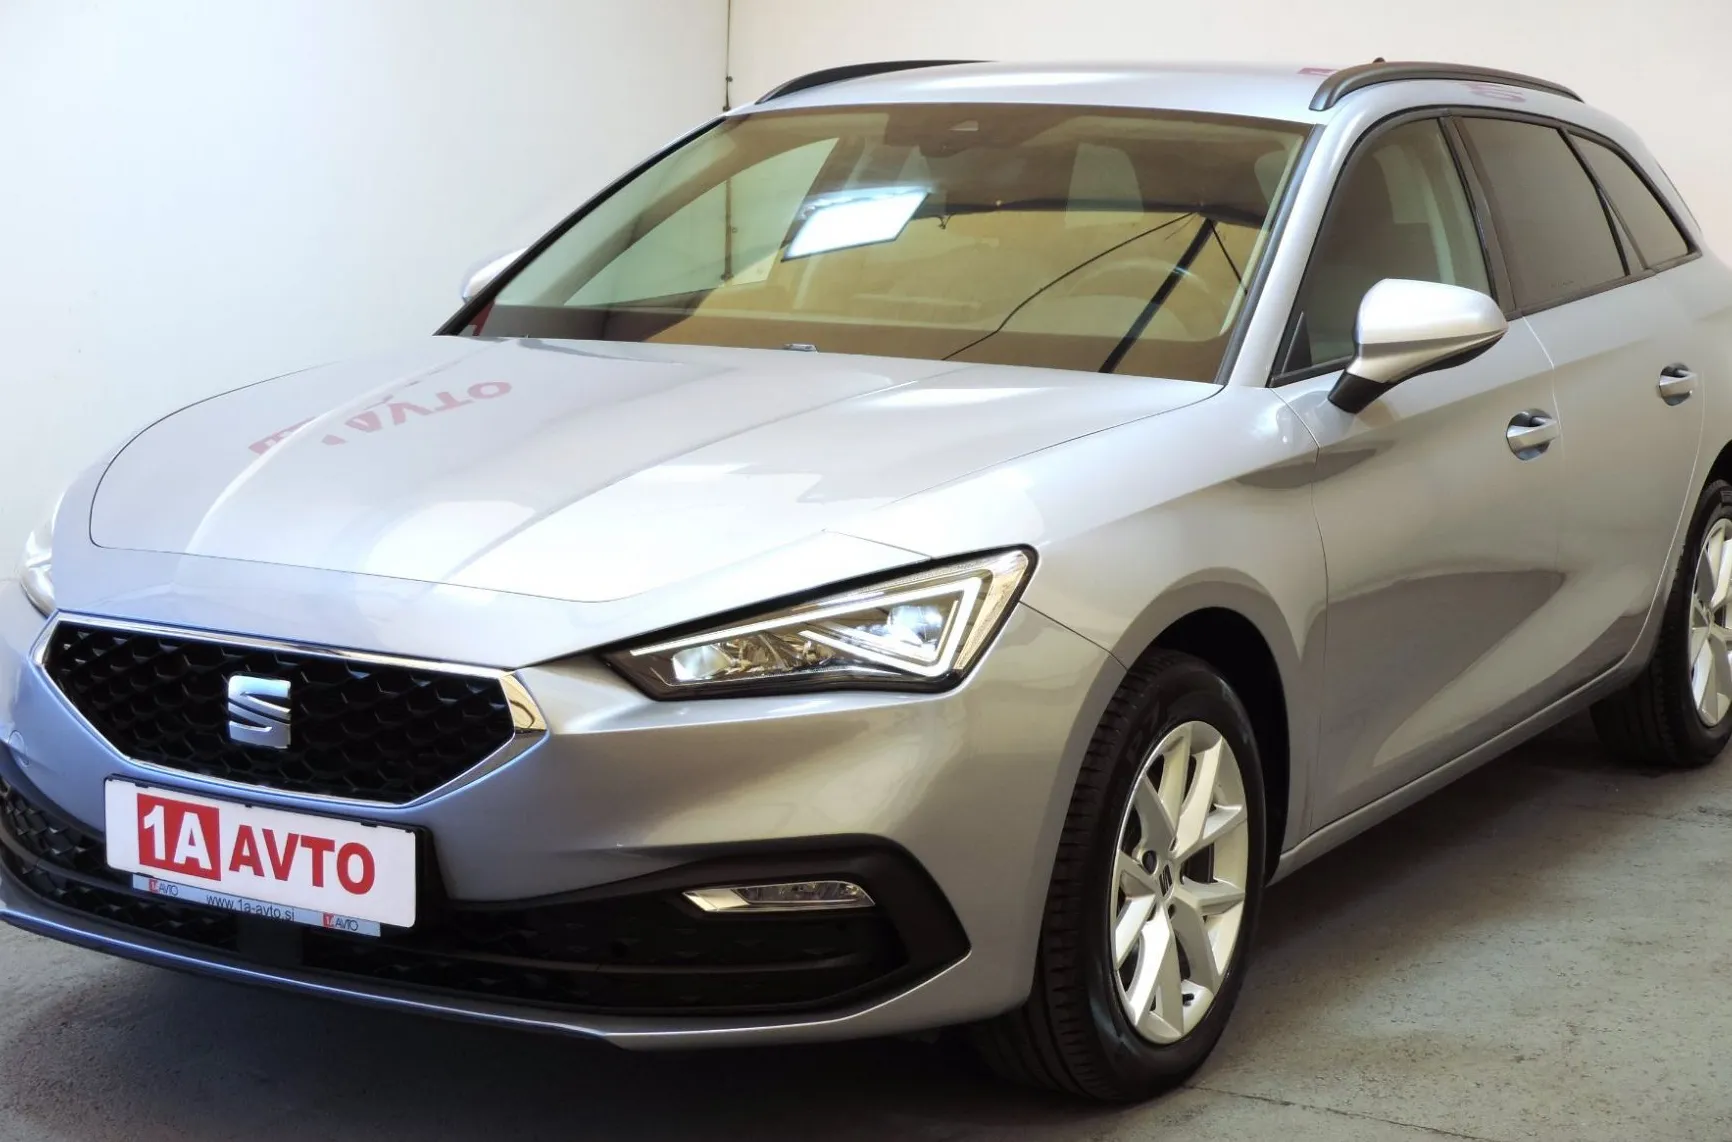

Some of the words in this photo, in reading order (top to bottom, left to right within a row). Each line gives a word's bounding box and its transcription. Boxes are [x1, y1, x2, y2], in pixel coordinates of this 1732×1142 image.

[143, 804, 213, 870] 1A
[229, 824, 376, 895] AVTO
[206, 895, 295, 922] www.1a-avto.si
